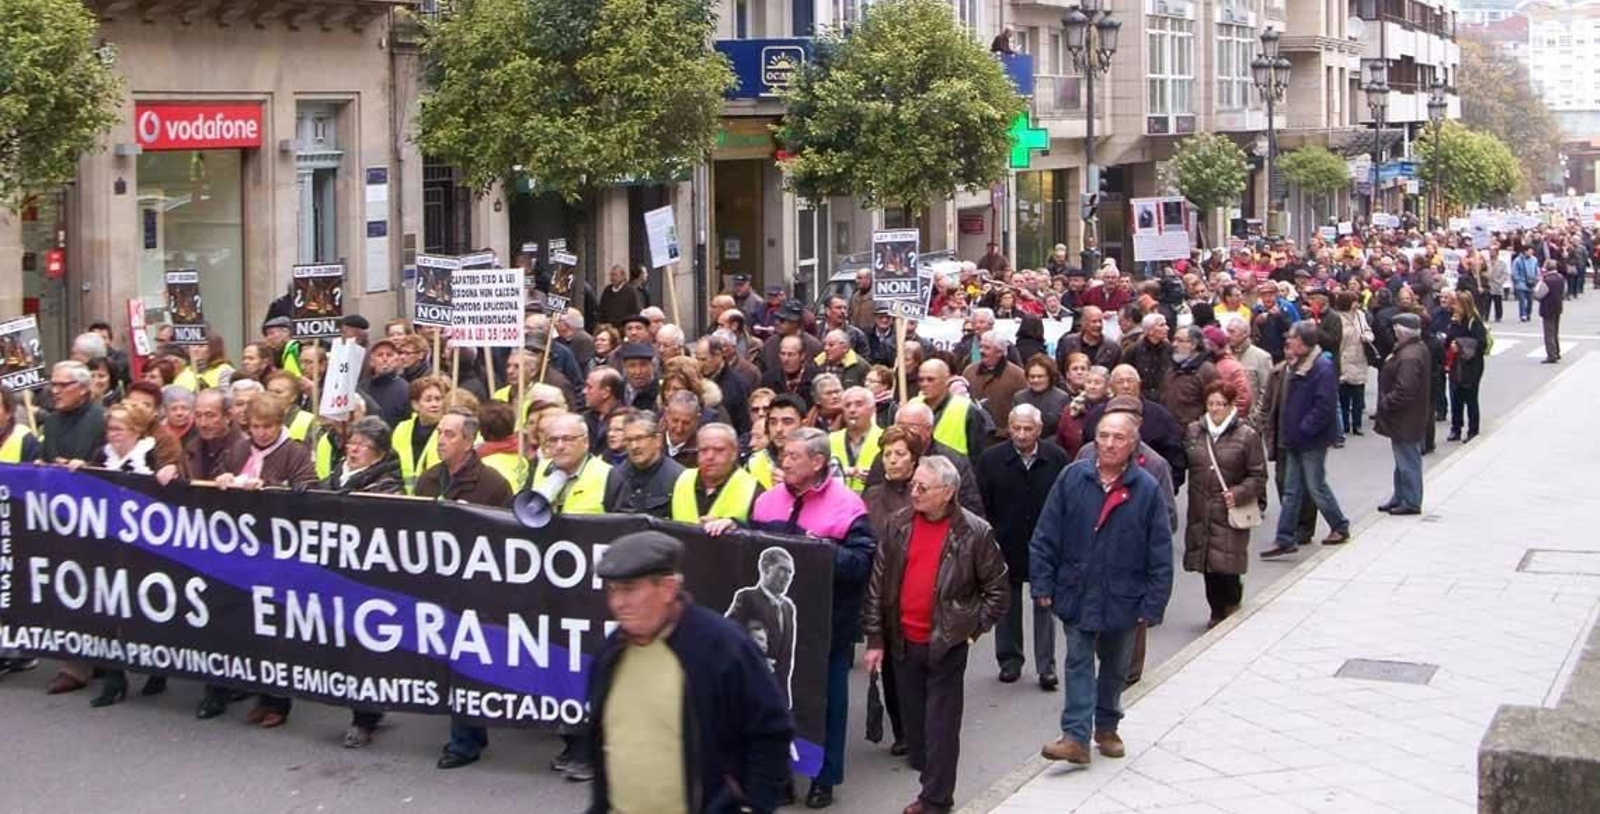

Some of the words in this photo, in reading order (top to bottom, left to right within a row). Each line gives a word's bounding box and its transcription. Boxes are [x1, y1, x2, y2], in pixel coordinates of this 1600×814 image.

[165, 113, 258, 140] vodafone
[877, 281, 916, 293] NON.
[296, 320, 340, 335] NON.
[26, 491, 107, 538] NON
[118, 500, 260, 556] SOMOS
[29, 557, 210, 628] FOMOS
[126, 642, 256, 682] PROVINCIAL
[261, 662, 287, 687] DE
[293, 665, 439, 706] EMIGRANTES
